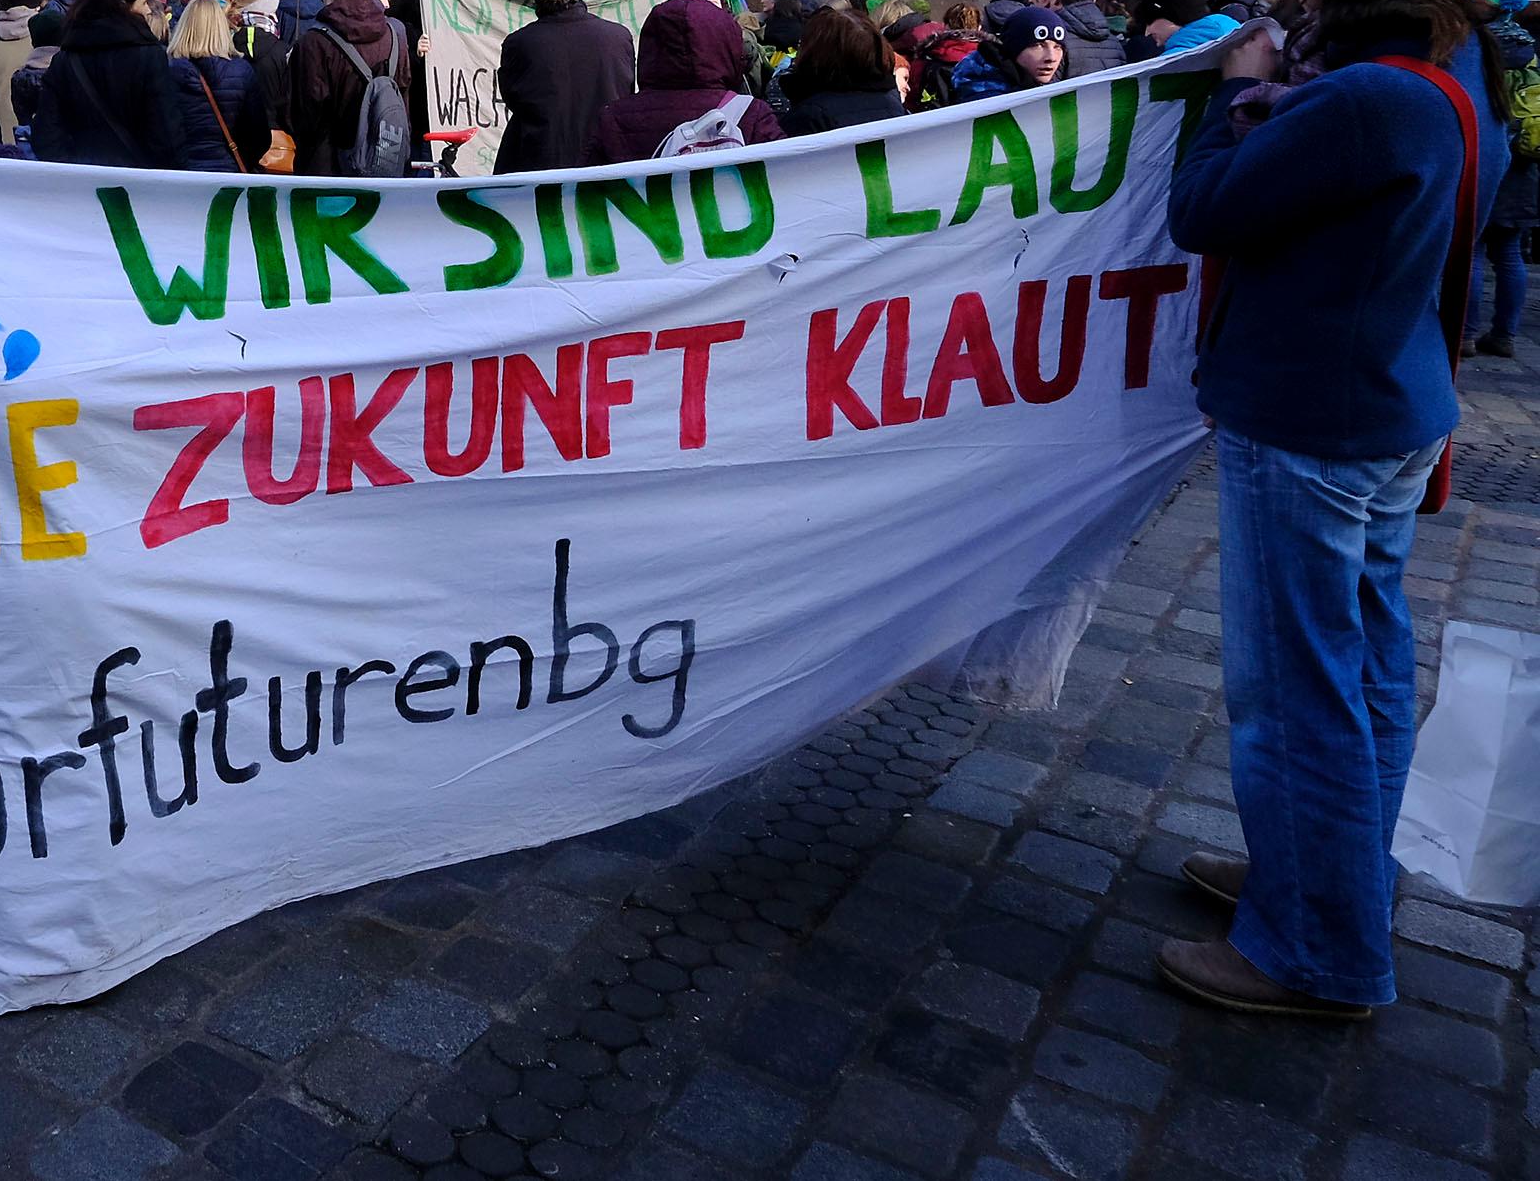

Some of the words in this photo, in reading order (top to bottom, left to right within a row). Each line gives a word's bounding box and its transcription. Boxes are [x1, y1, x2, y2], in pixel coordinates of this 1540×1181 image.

[96, 185, 409, 325] WIR
[443, 160, 775, 291] SIND
[854, 68, 1222, 237] LAUT
[132, 319, 745, 548] ZUKUNFT
